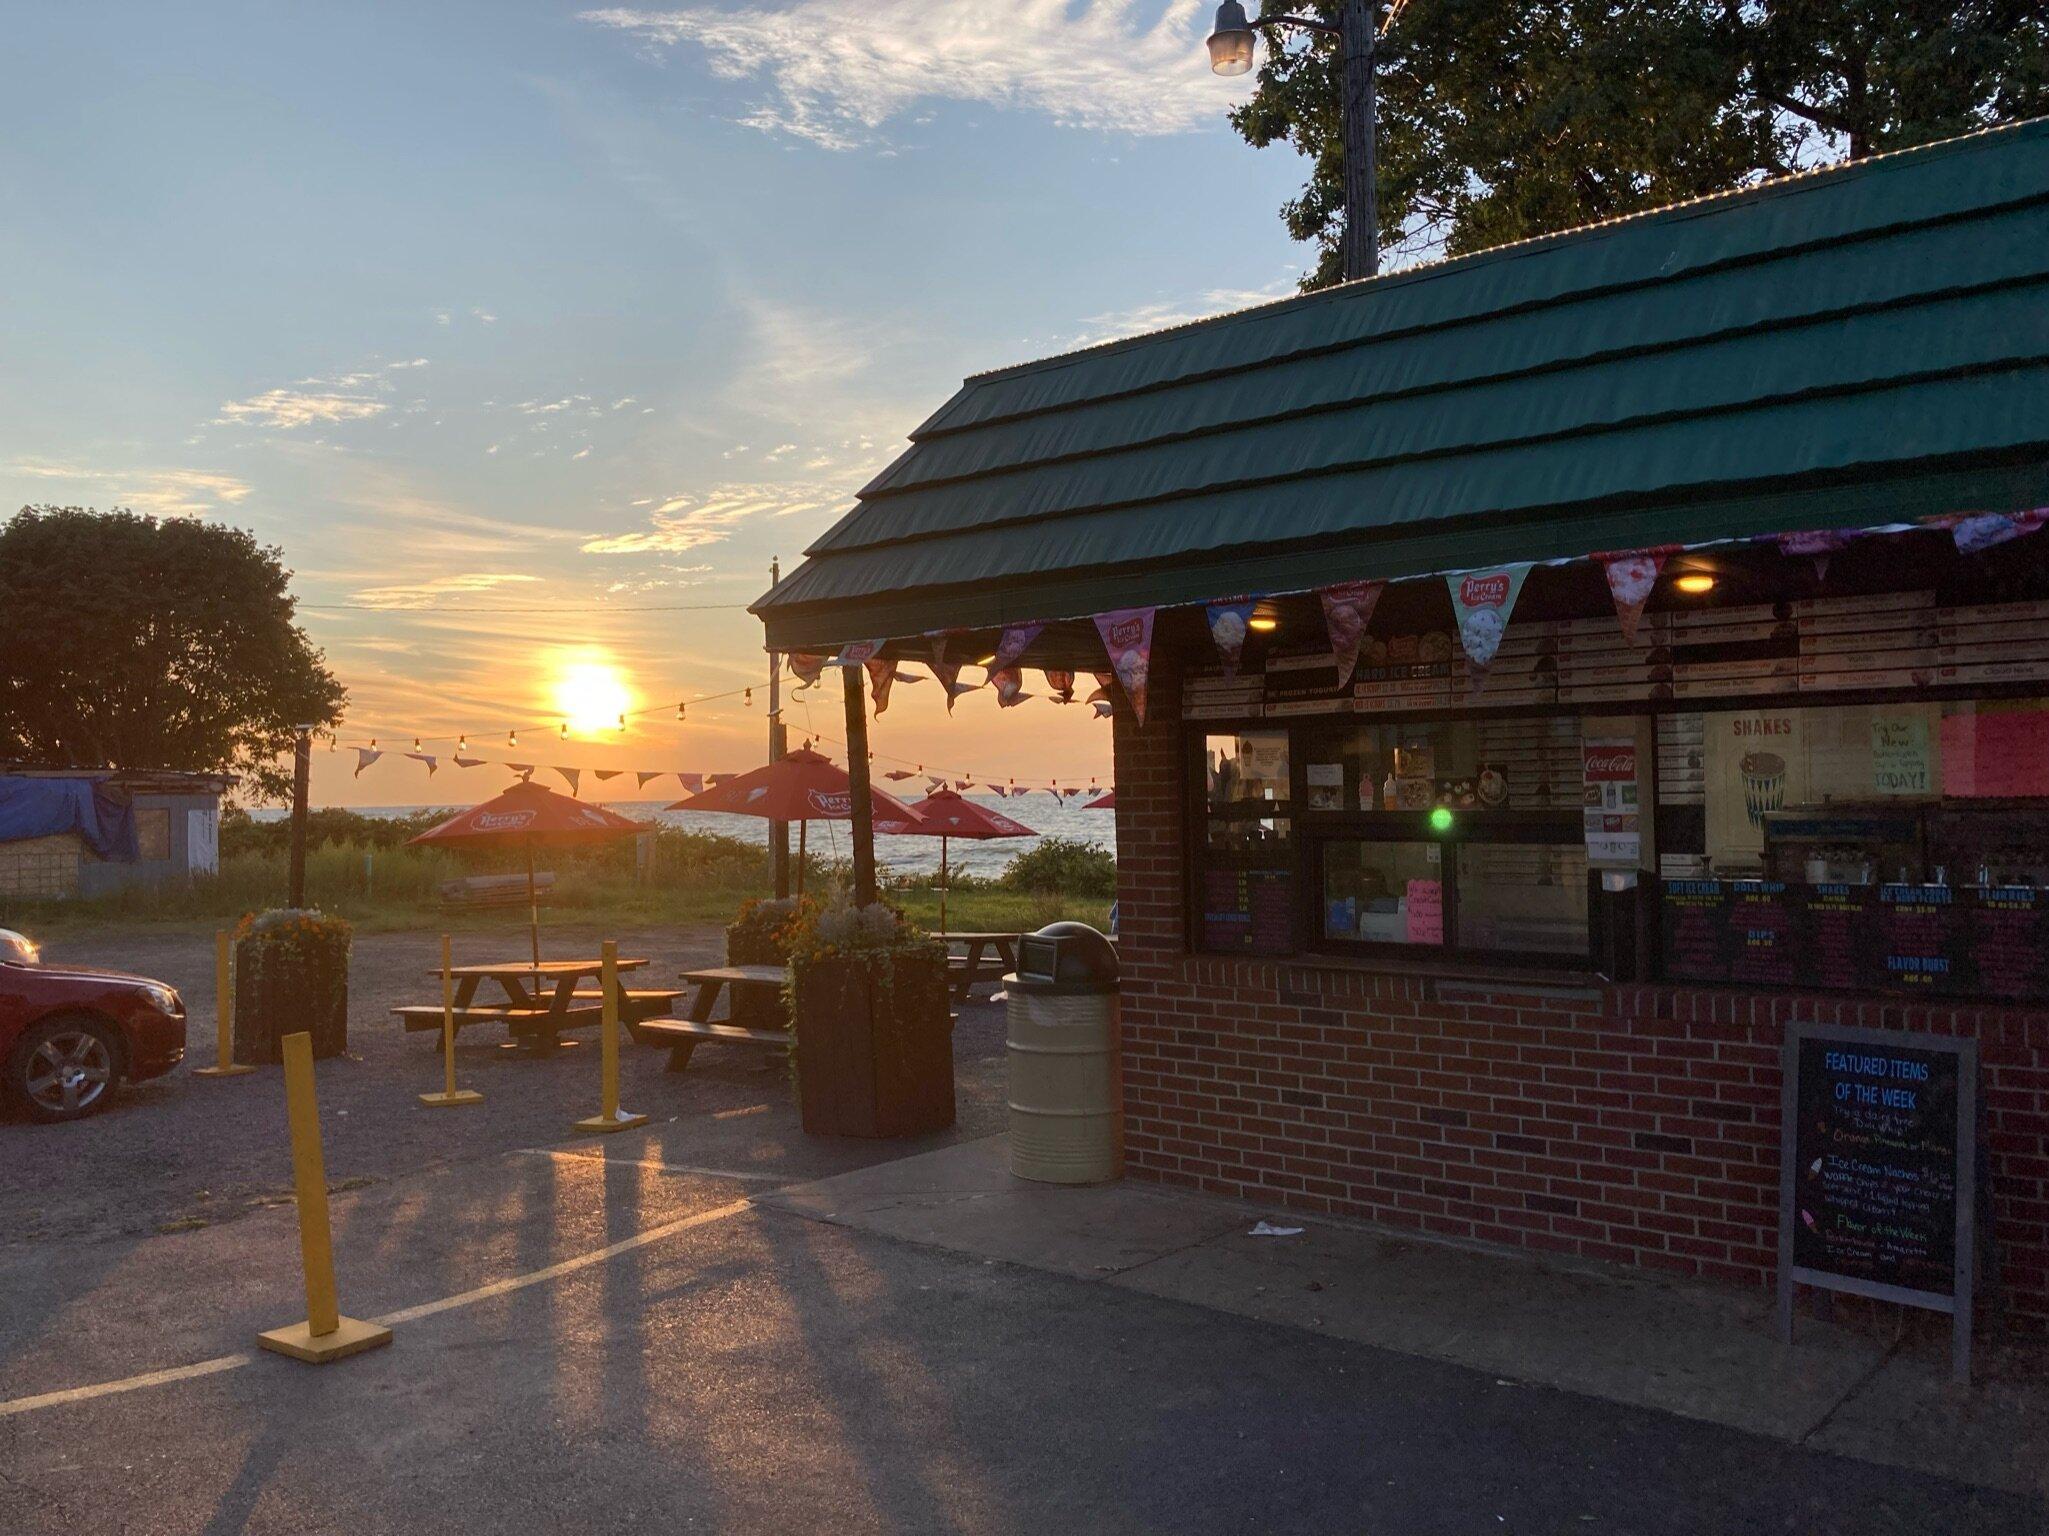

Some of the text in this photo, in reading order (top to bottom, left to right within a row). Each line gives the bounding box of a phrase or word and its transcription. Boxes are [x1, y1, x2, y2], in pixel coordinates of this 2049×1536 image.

[1466, 579, 1504, 597] Perry's
[1112, 621, 1140, 640] Perry's
[1356, 662, 1450, 681] HARD ICE CREAM
[1279, 688, 1307, 698] FROZEN
[1733, 718, 1792, 736] SHAKES
[1872, 721, 1909, 736] Try Our
[1875, 771, 1926, 790] TODAY!
[1733, 882, 1786, 894] DOLE WHIP
[1817, 884, 1850, 895] SHAKES
[1979, 889, 2036, 901] FLURRIES
[1747, 930, 1775, 940] DIPS
[1887, 956, 1950, 973] FLAVOR BURST
[1825, 1052, 1929, 1082] FEATURED ITEMS
[1835, 1082, 1917, 1110] OF THE WEEK
[1827, 1153, 1920, 1182] Ice Cream Nachos
[1871, 1221, 1883, 1235] of
[1884, 1225, 1899, 1238] the
